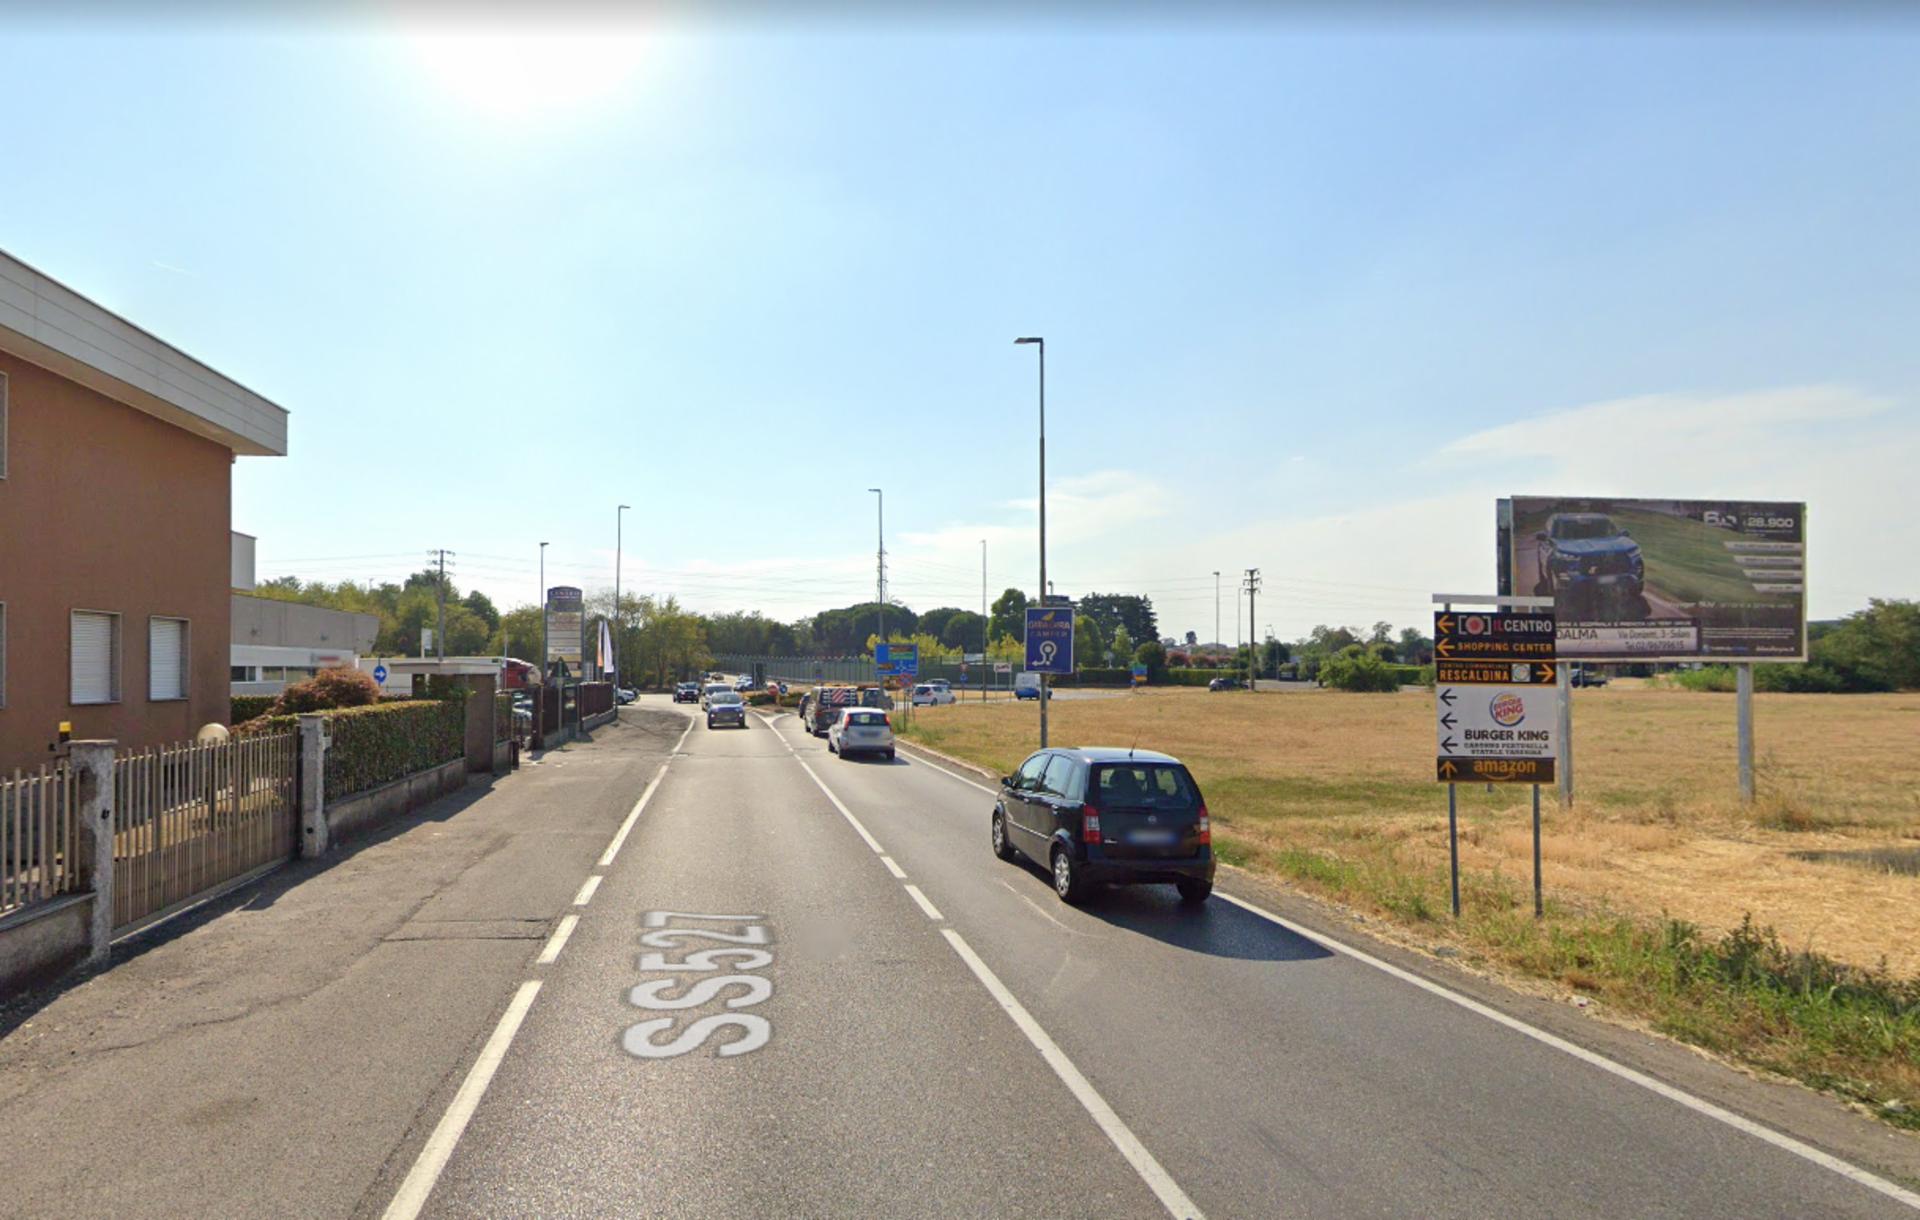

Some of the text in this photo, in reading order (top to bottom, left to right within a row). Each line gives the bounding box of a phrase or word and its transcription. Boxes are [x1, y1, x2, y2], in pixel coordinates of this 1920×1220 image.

[1458, 642, 1553, 653] SHOPPING CENTER
[1440, 669, 1510, 681] RESCALDINA
[1495, 705, 1524, 719] KING
[1464, 729, 1549, 741] BURGER KING
[1473, 760, 1537, 773] amazon
